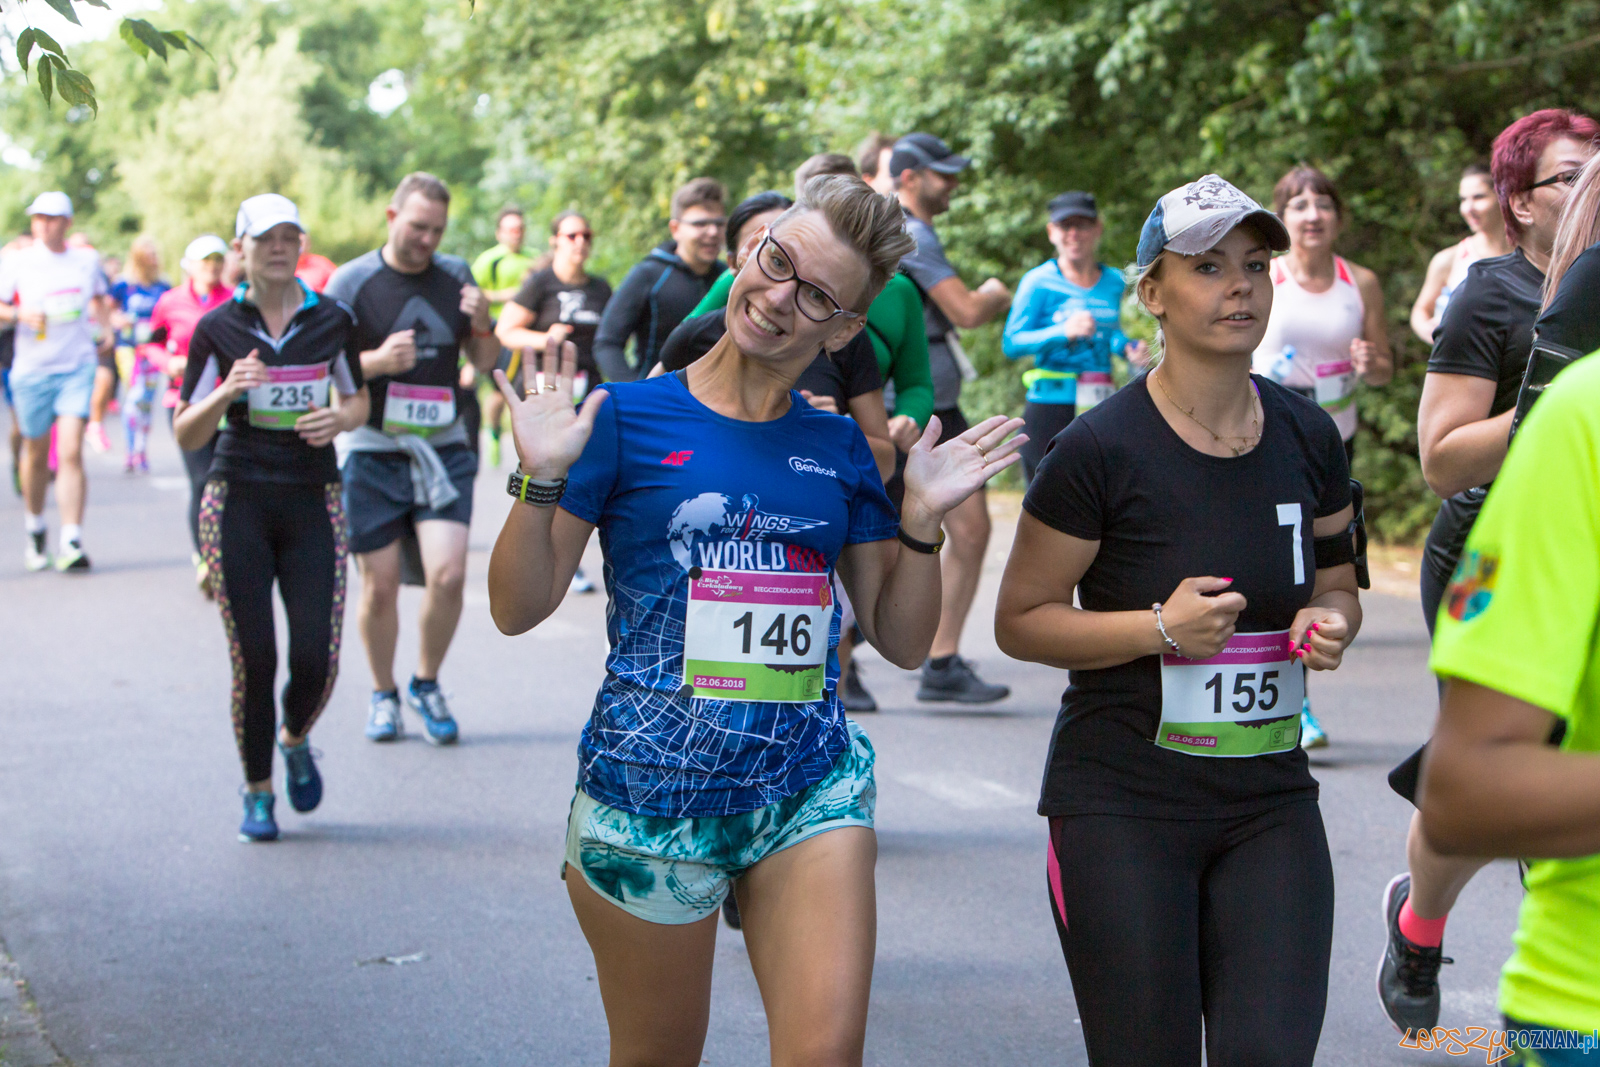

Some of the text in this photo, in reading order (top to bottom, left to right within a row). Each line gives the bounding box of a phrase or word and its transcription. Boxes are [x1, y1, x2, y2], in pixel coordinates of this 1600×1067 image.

[270, 385, 314, 407] 235
[405, 403, 440, 421] 180
[660, 450, 694, 466] 4F
[726, 512, 791, 531] WINGS
[731, 528, 771, 541] LIFE
[1276, 503, 1305, 585] 7
[698, 540, 785, 571] WORLD
[733, 611, 812, 657] 146
[695, 677, 744, 688] 22.06.2018
[1205, 670, 1279, 714] 155
[1169, 734, 1216, 746] 22.06.2018
